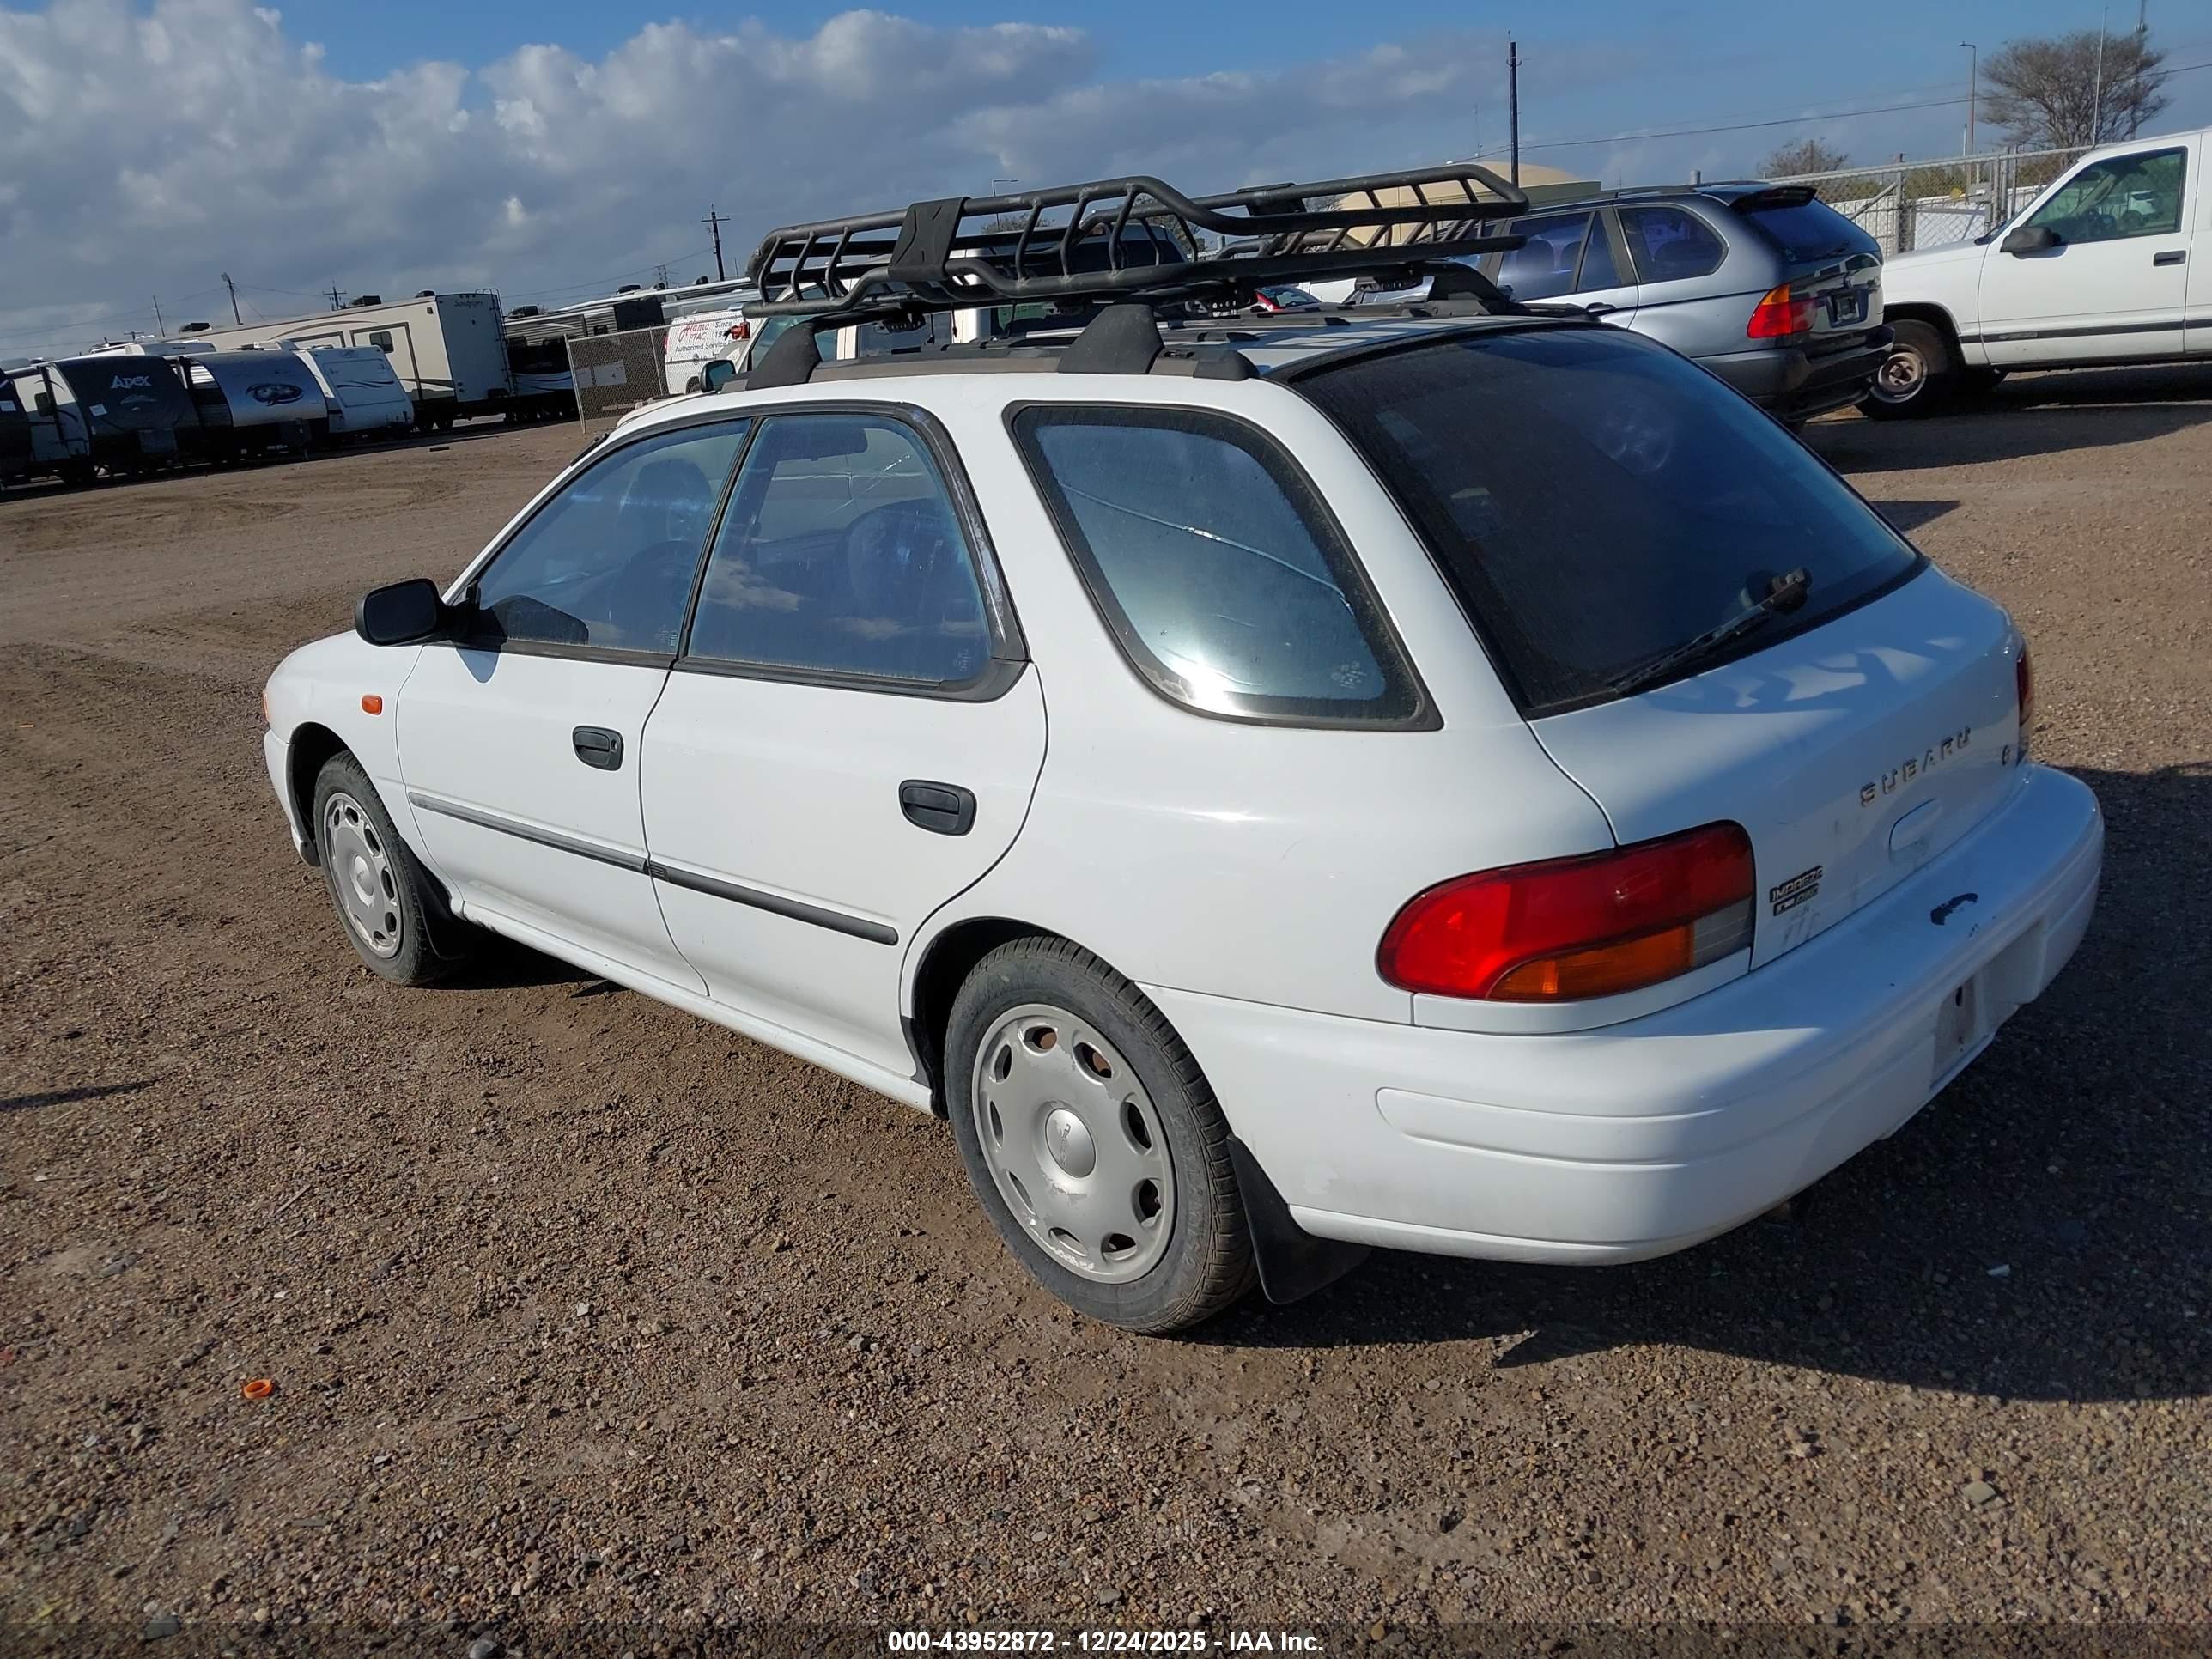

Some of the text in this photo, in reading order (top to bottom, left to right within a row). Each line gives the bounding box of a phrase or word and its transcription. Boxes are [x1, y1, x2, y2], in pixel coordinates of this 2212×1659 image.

[678, 320, 709, 343] Alamo
[690, 332, 707, 341] PTAC
[676, 343, 704, 352] Authorized
[1859, 726, 1972, 807] SUBARU
